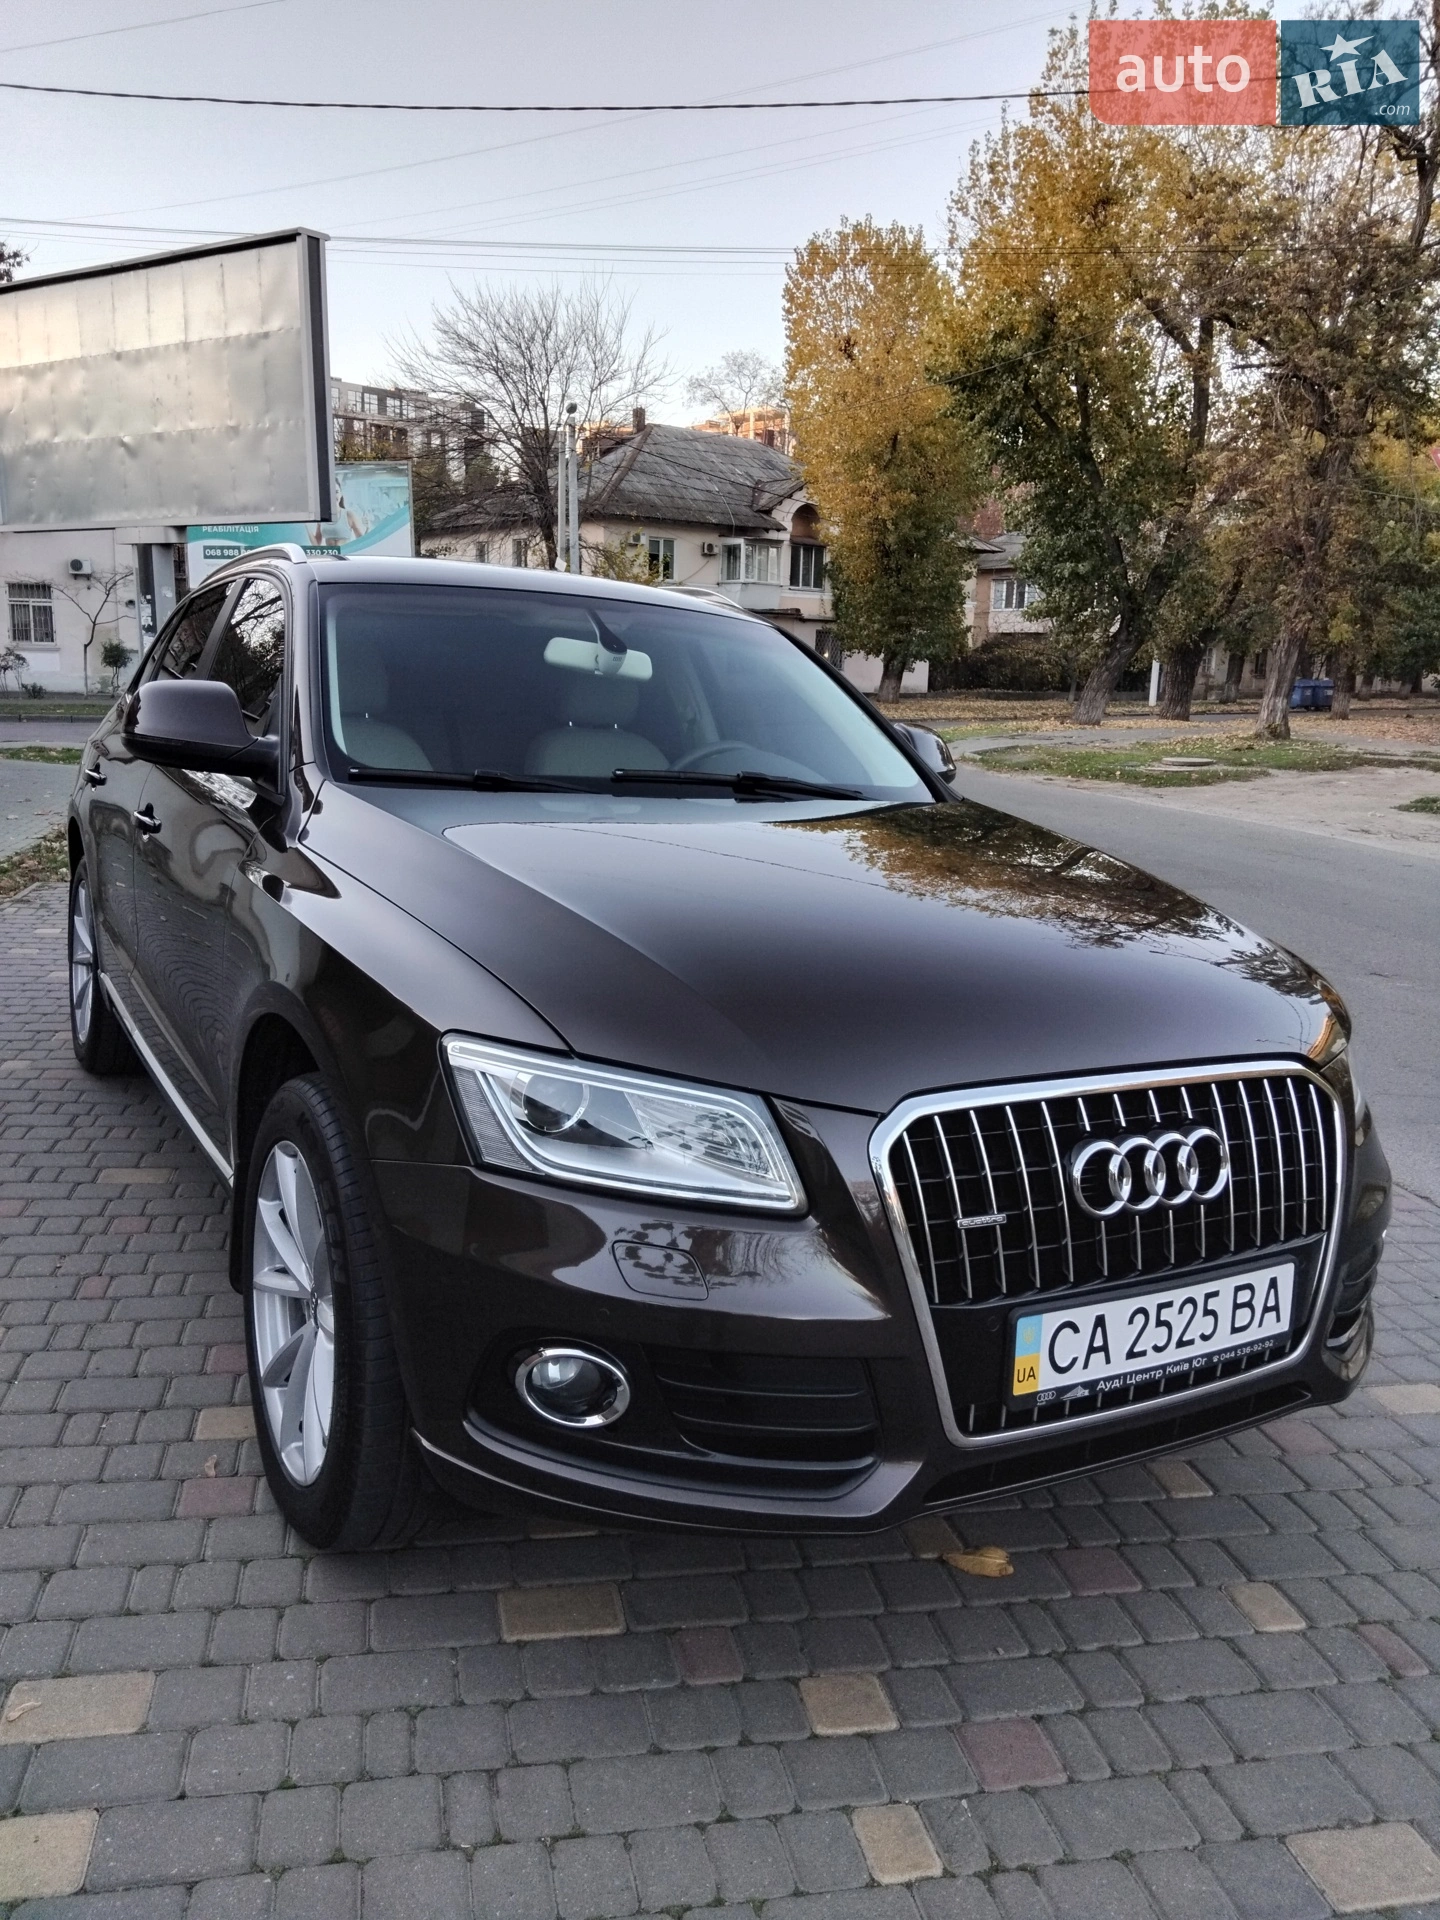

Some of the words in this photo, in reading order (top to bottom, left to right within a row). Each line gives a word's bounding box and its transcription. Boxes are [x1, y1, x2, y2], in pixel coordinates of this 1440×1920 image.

[202, 525, 259, 533] РЕАБІЛІТАЦІЯ
[1048, 1313, 1112, 1374] CA
[1125, 1289, 1221, 1361] 2525
[1230, 1276, 1281, 1335] BA
[1016, 1366, 1036, 1384] UA
[1096, 1376, 1123, 1391] Ауді
[1126, 1370, 1163, 1385] Центр
[1166, 1362, 1189, 1375] Київ
[1192, 1357, 1207, 1368] Юг
[1220, 1352, 1235, 1361] 044
[1236, 1339, 1274, 1356] 536-92-92
